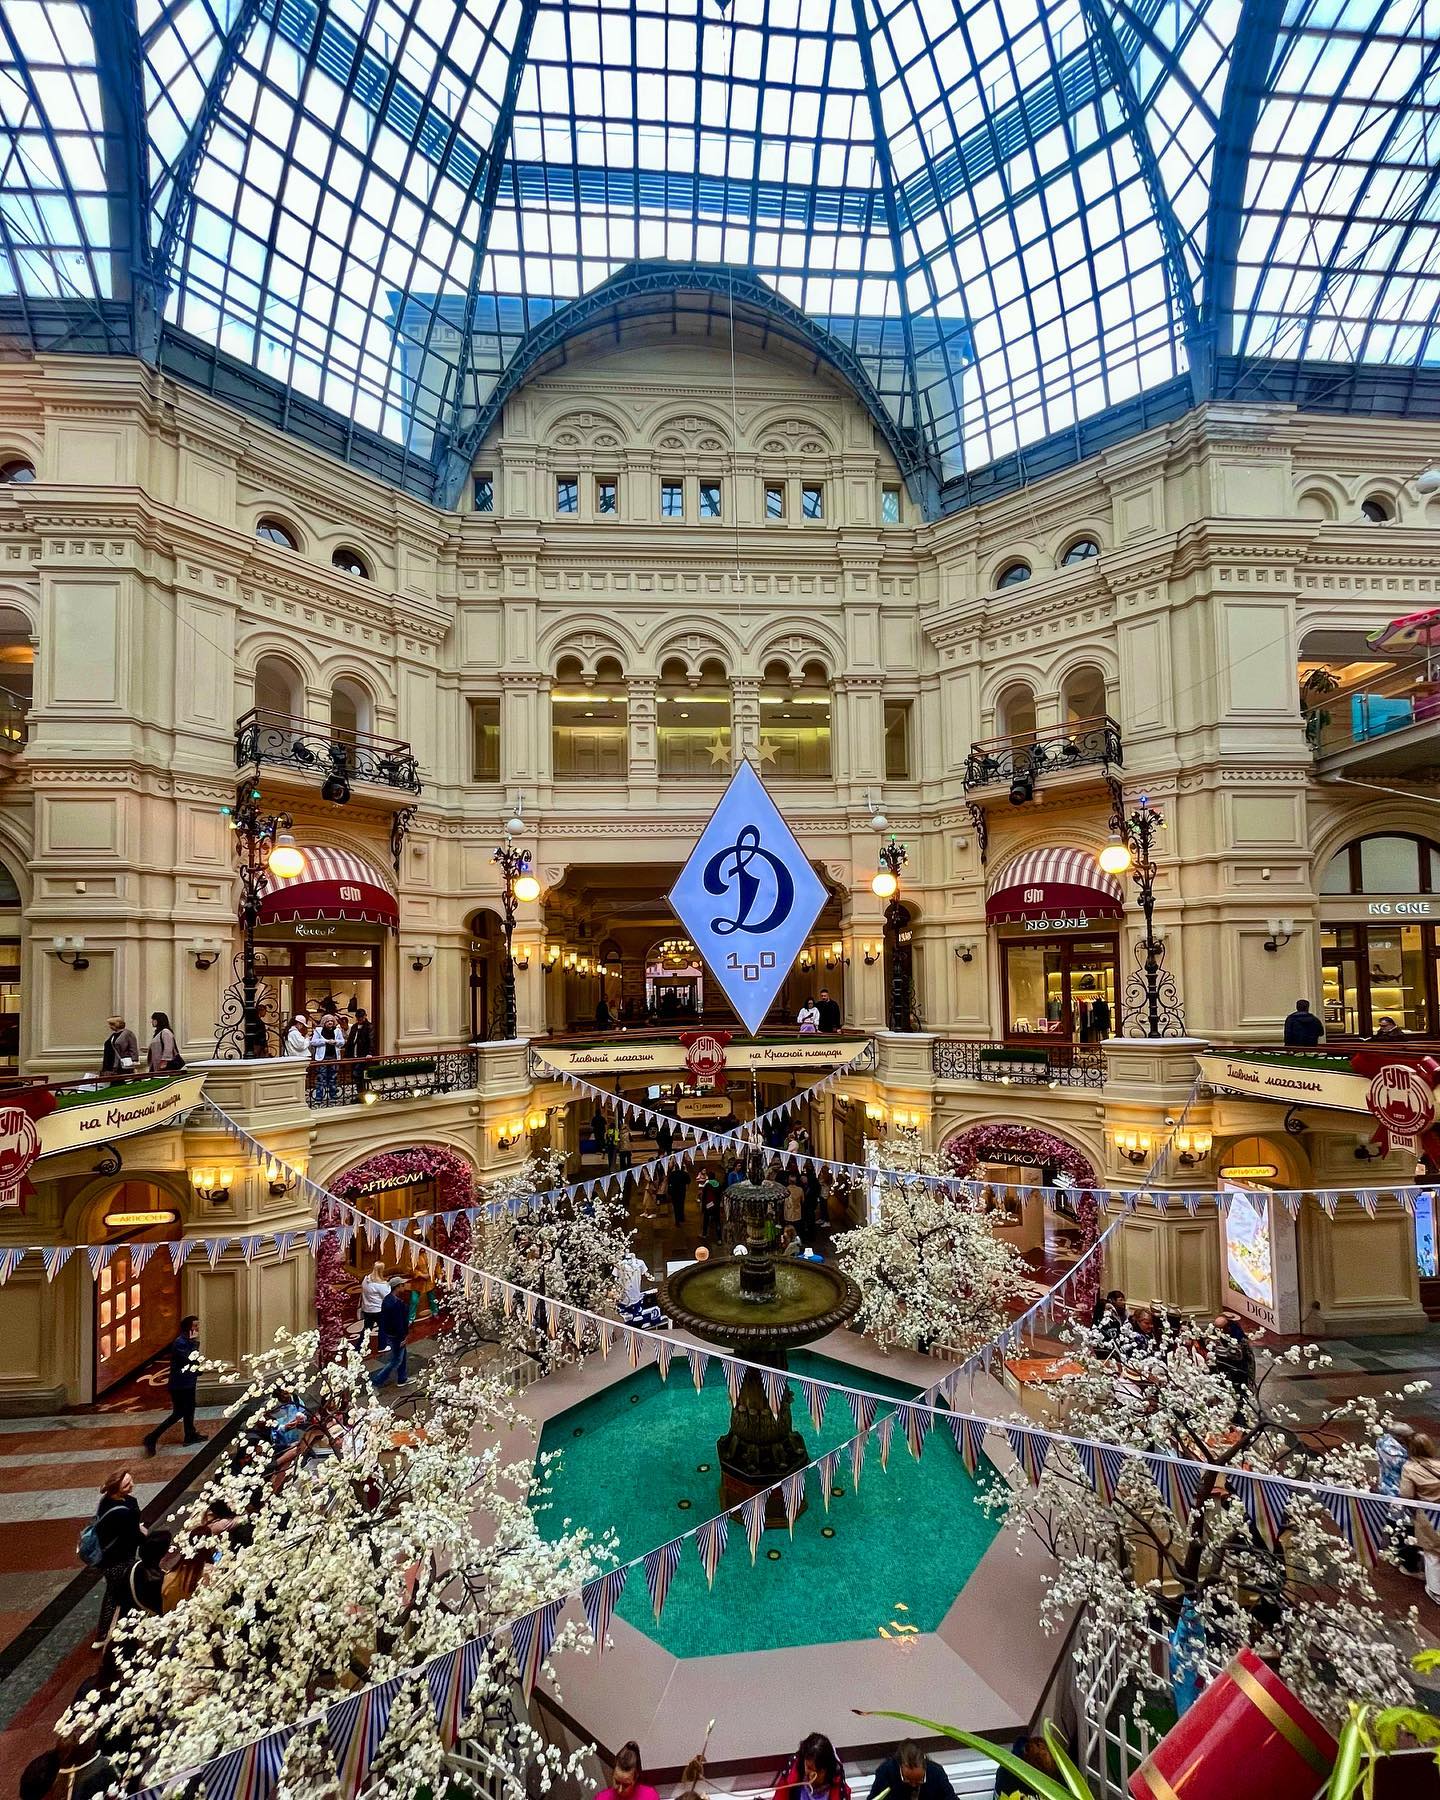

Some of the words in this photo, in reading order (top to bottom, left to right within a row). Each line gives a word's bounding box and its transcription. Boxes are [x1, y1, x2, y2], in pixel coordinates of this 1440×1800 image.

[1368, 902, 1391, 914] NO
[1395, 902, 1431, 914] ONE
[1025, 920, 1049, 931] NO
[1052, 918, 1089, 930] ONE
[569, 1053, 609, 1064] Главный
[613, 1054, 655, 1062] магазин
[764, 1049, 804, 1061] Красной
[805, 1050, 843, 1059] площади
[1226, 1064, 1261, 1084] Главный
[1264, 1077, 1323, 1092] магазин
[79, 1117, 101, 1132] на
[106, 1102, 156, 1128] Красной
[988, 1152, 1051, 1166] АРТИКОЛИ
[360, 1171, 424, 1194] АРТИКОЛИ
[1246, 1300, 1276, 1325] DIOR
